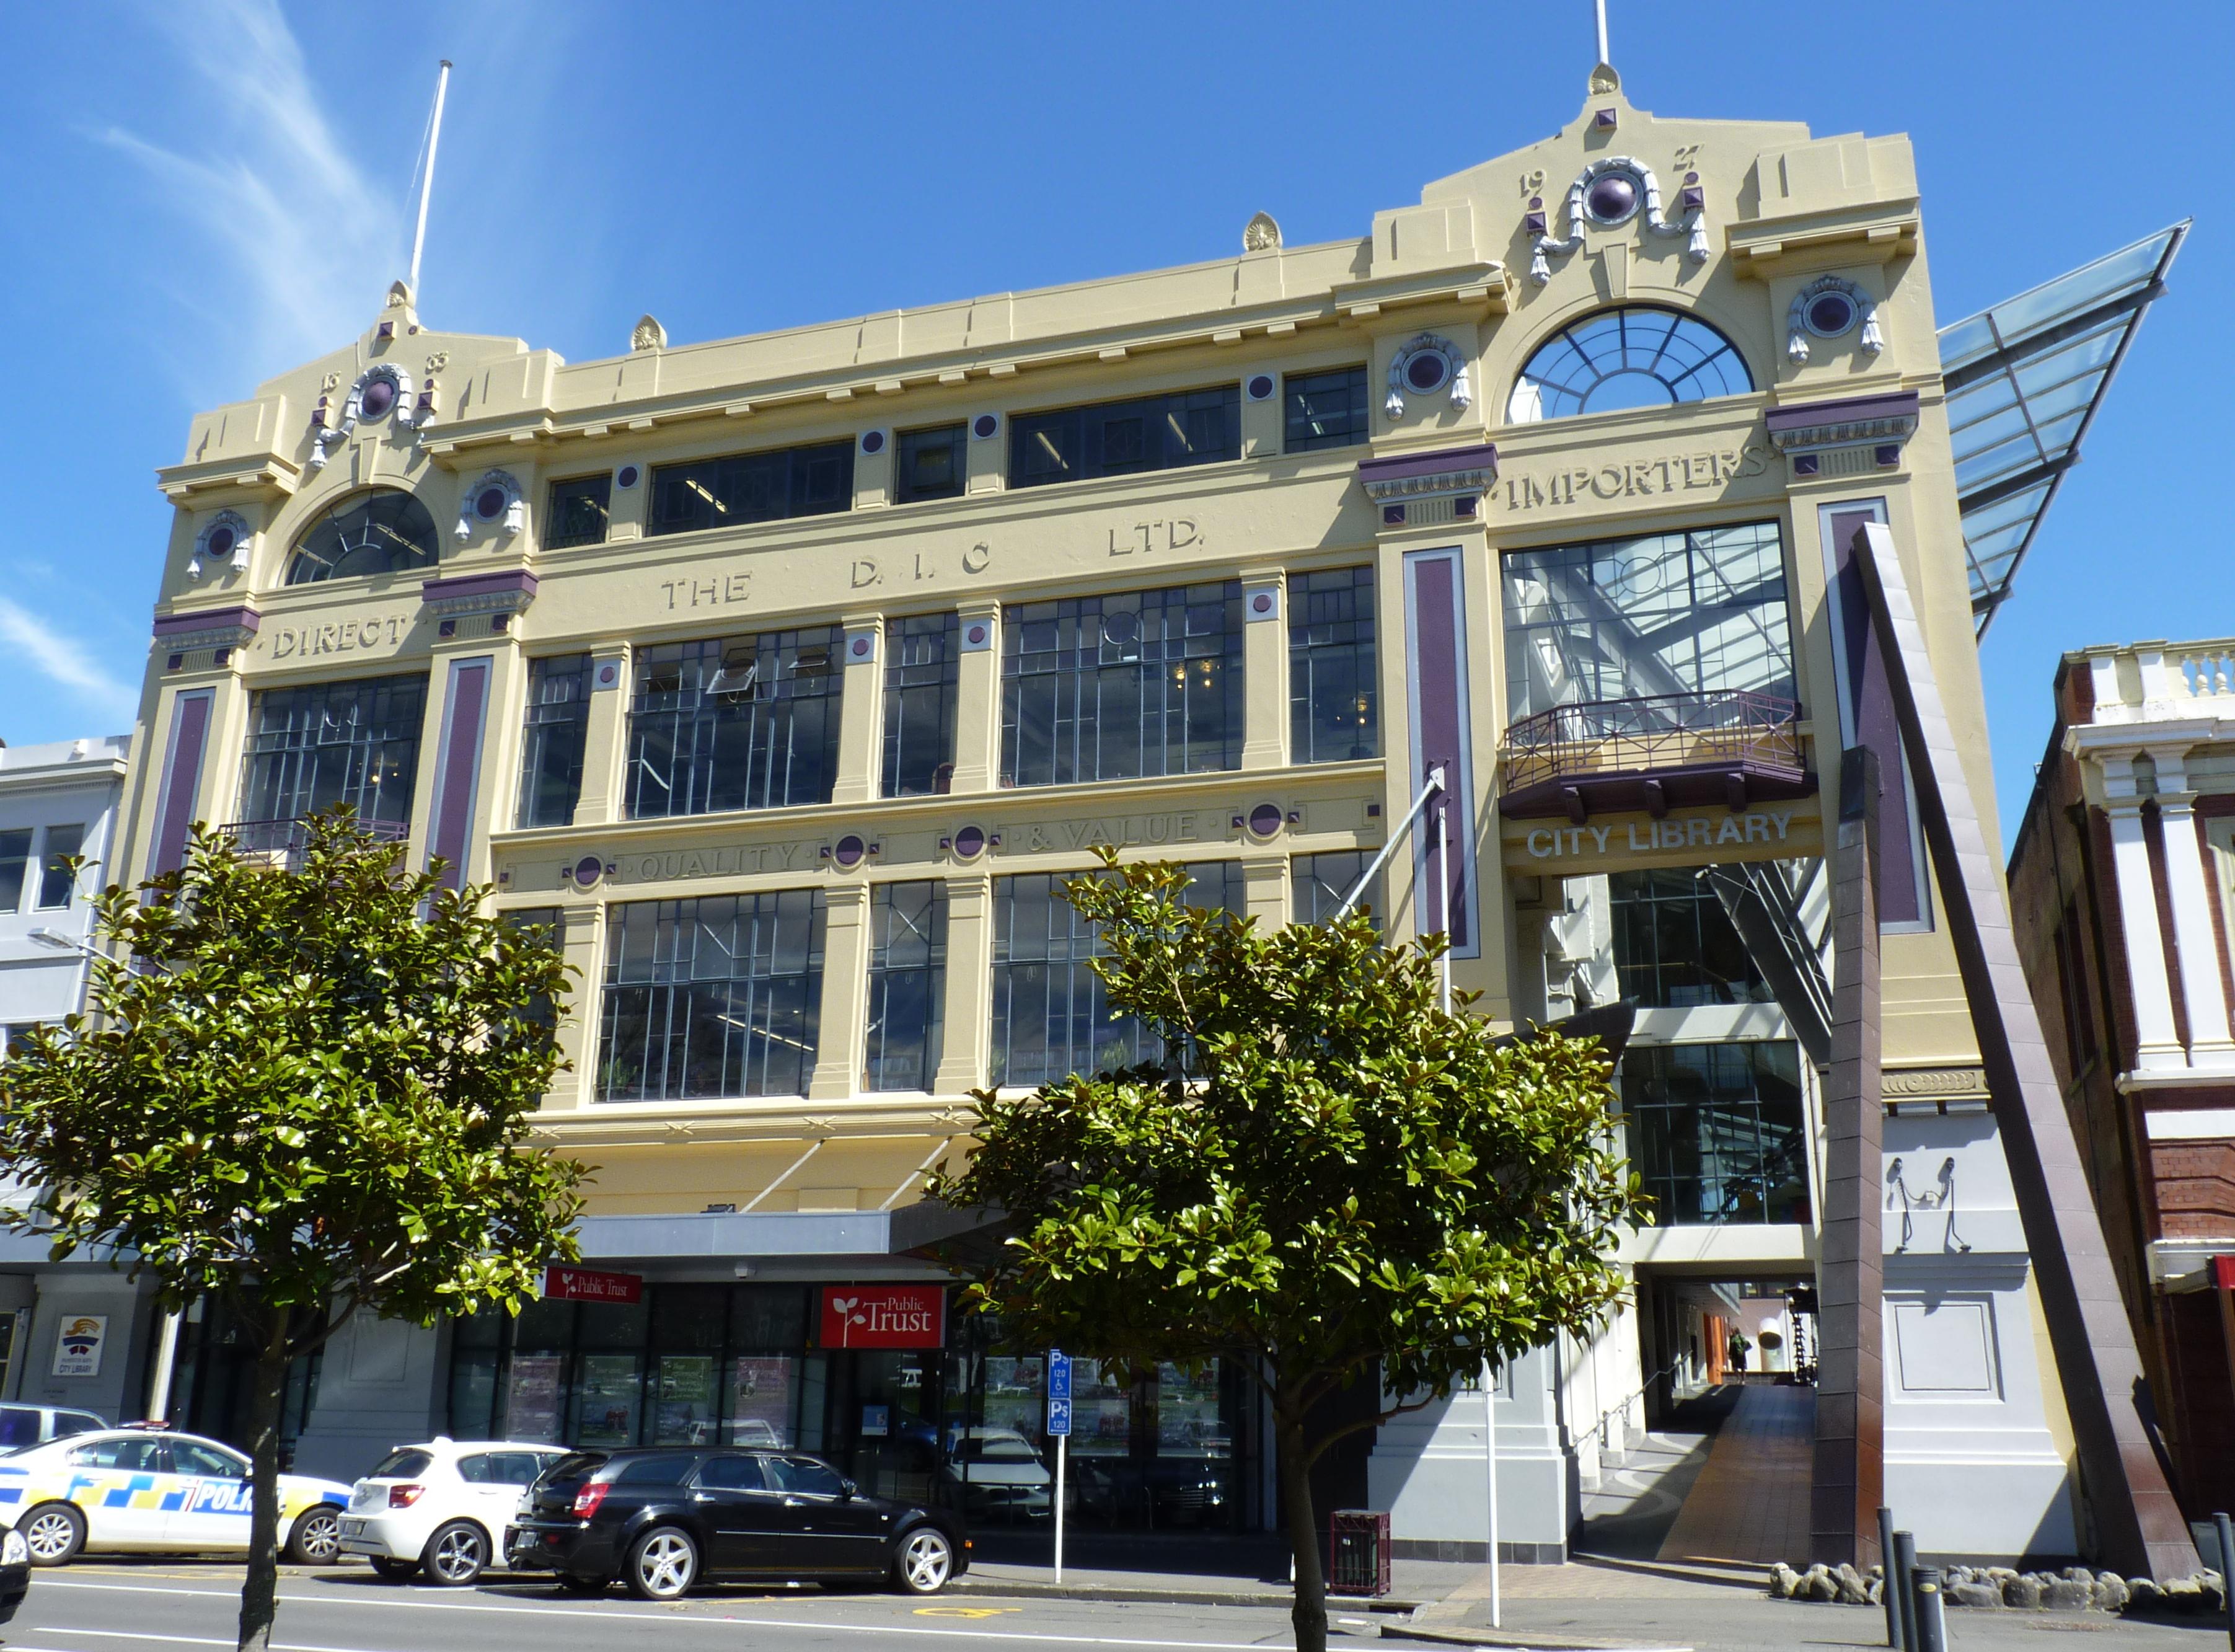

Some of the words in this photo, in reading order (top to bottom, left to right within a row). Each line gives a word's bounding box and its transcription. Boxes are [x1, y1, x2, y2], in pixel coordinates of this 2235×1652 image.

[1519, 169, 1547, 198] 19
[1507, 446, 1767, 511] IMPORTERS
[661, 570, 752, 610] THE
[271, 612, 409, 660] DIRECT
[640, 844, 800, 881] QUALITY
[1027, 825, 1052, 852] &
[1062, 811, 1199, 849] VALUE
[1527, 825, 1611, 858] CITY
[1628, 811, 1794, 850] LIBRARY
[578, 1276, 604, 1295] Public
[606, 1279, 628, 1297] Trust
[863, 1302, 932, 1332] Trust
[888, 1296, 924, 1311] Public
[1054, 1369, 1065, 1377] 120
[1053, 1420, 1065, 1428] 120
[195, 1483, 253, 1511] POLI
